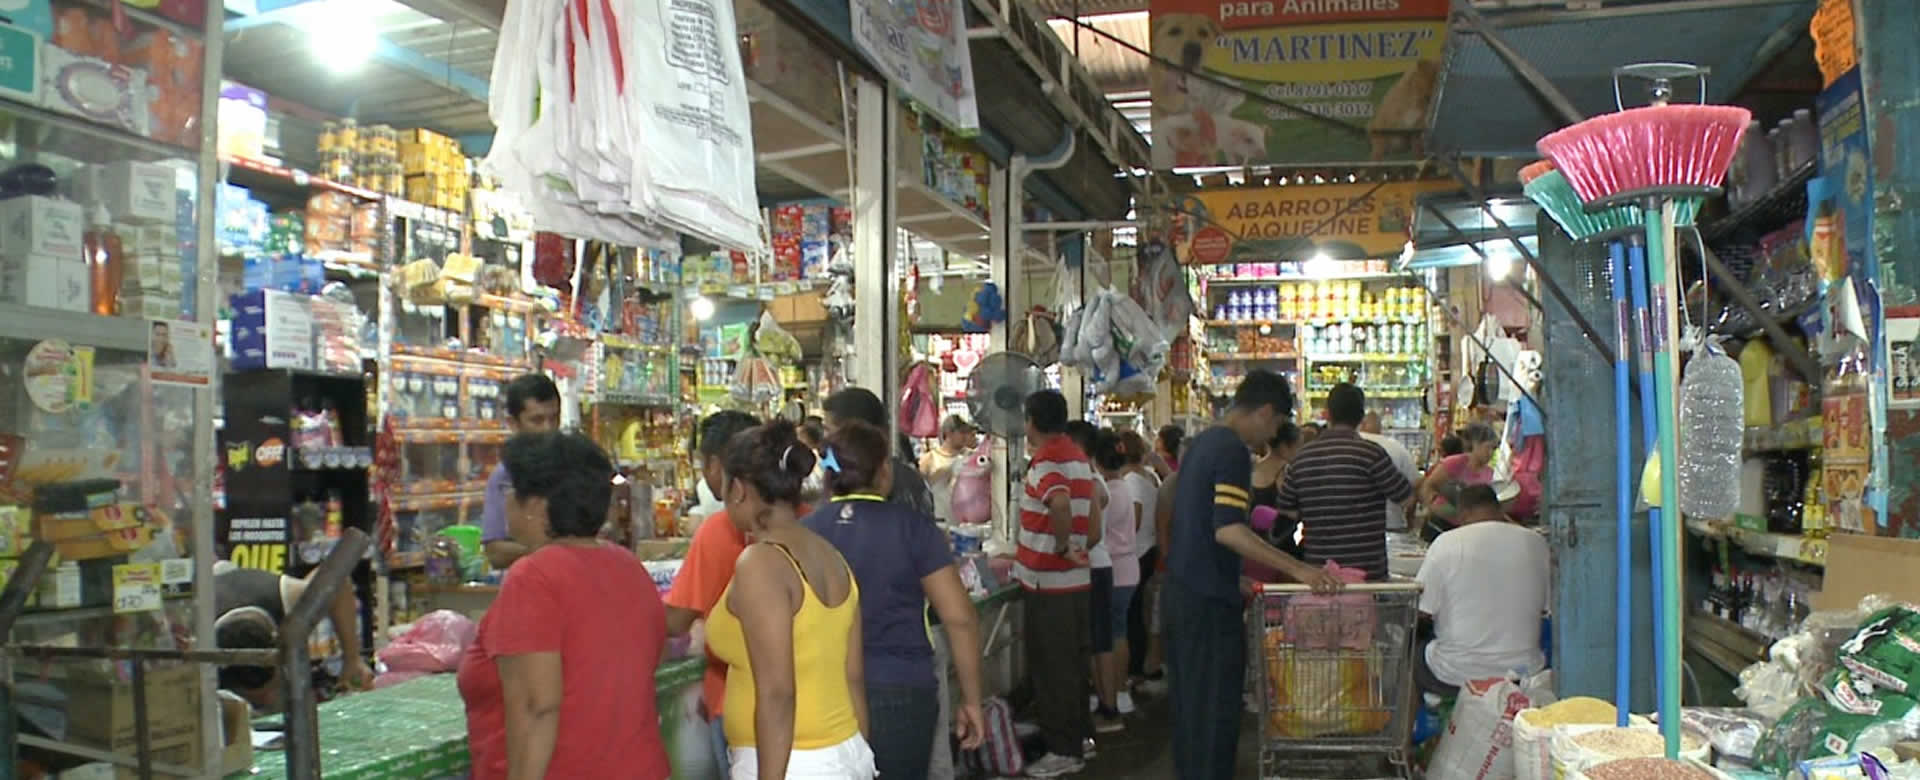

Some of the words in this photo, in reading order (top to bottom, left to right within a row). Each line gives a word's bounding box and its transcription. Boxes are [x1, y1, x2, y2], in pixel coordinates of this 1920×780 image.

[1220, 1, 1274, 21] para
[1282, 0, 1400, 15] Animales
[1226, 195, 1377, 221] ABARROTES
[1239, 216, 1371, 240] JAQUELINE
